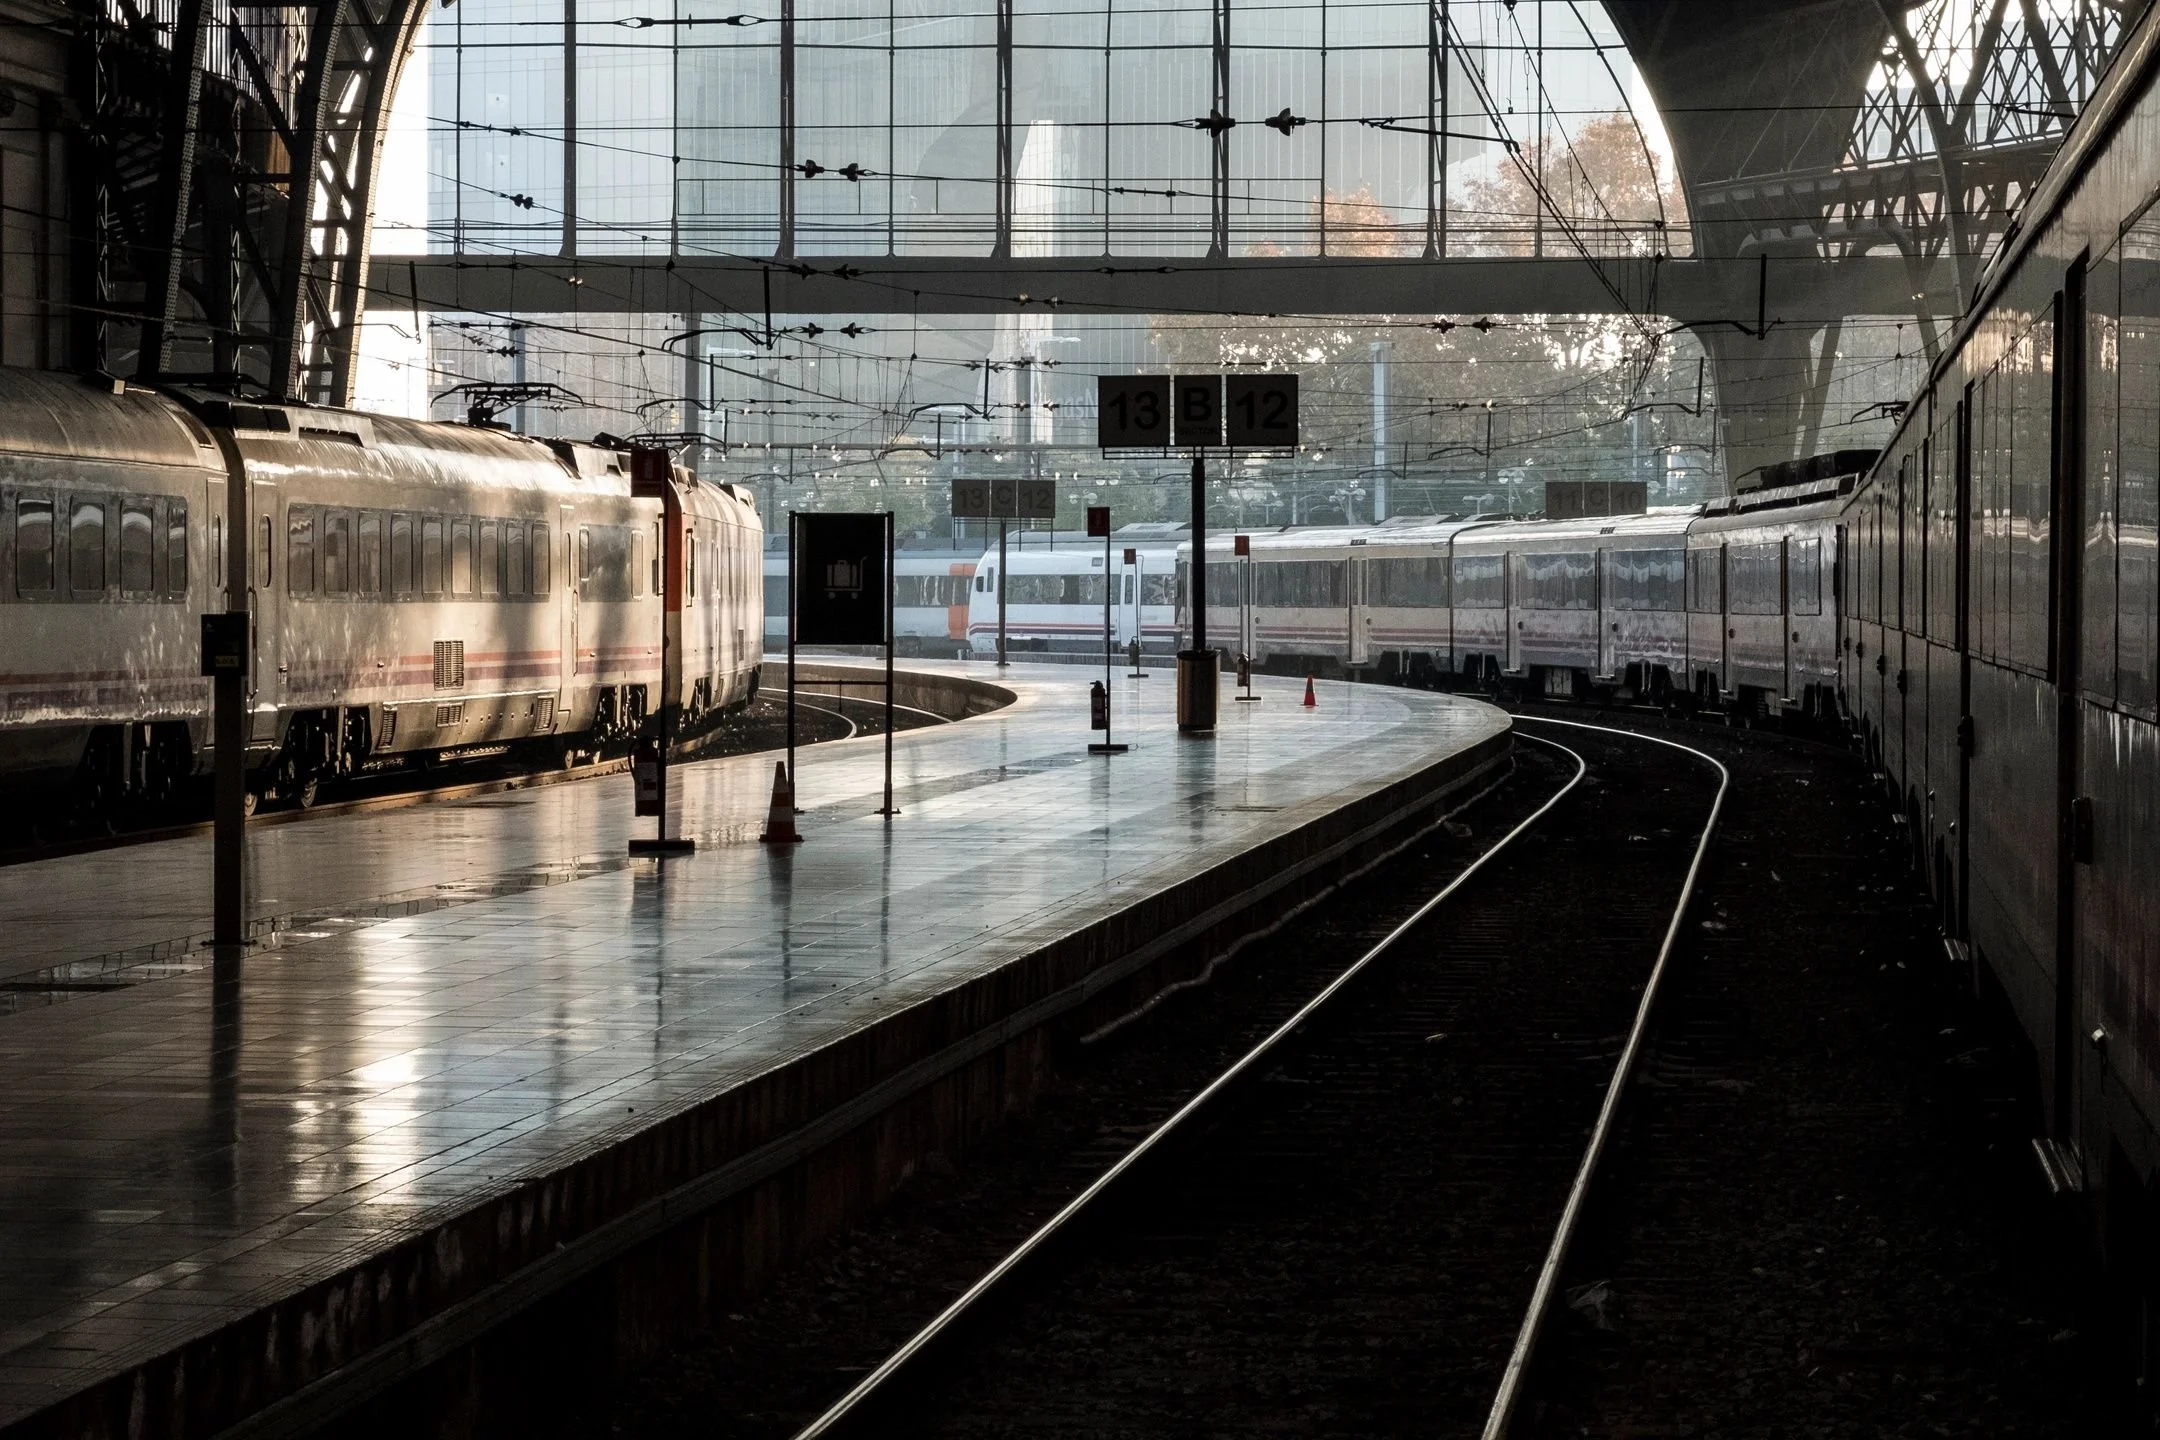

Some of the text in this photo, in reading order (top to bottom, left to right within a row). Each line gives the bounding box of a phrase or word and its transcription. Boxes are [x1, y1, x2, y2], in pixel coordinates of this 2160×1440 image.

[1108, 386, 1289, 431] 13 B 12
[960, 486, 1050, 509] 13 C 12
[1552, 488, 1642, 511] 11 C 10
